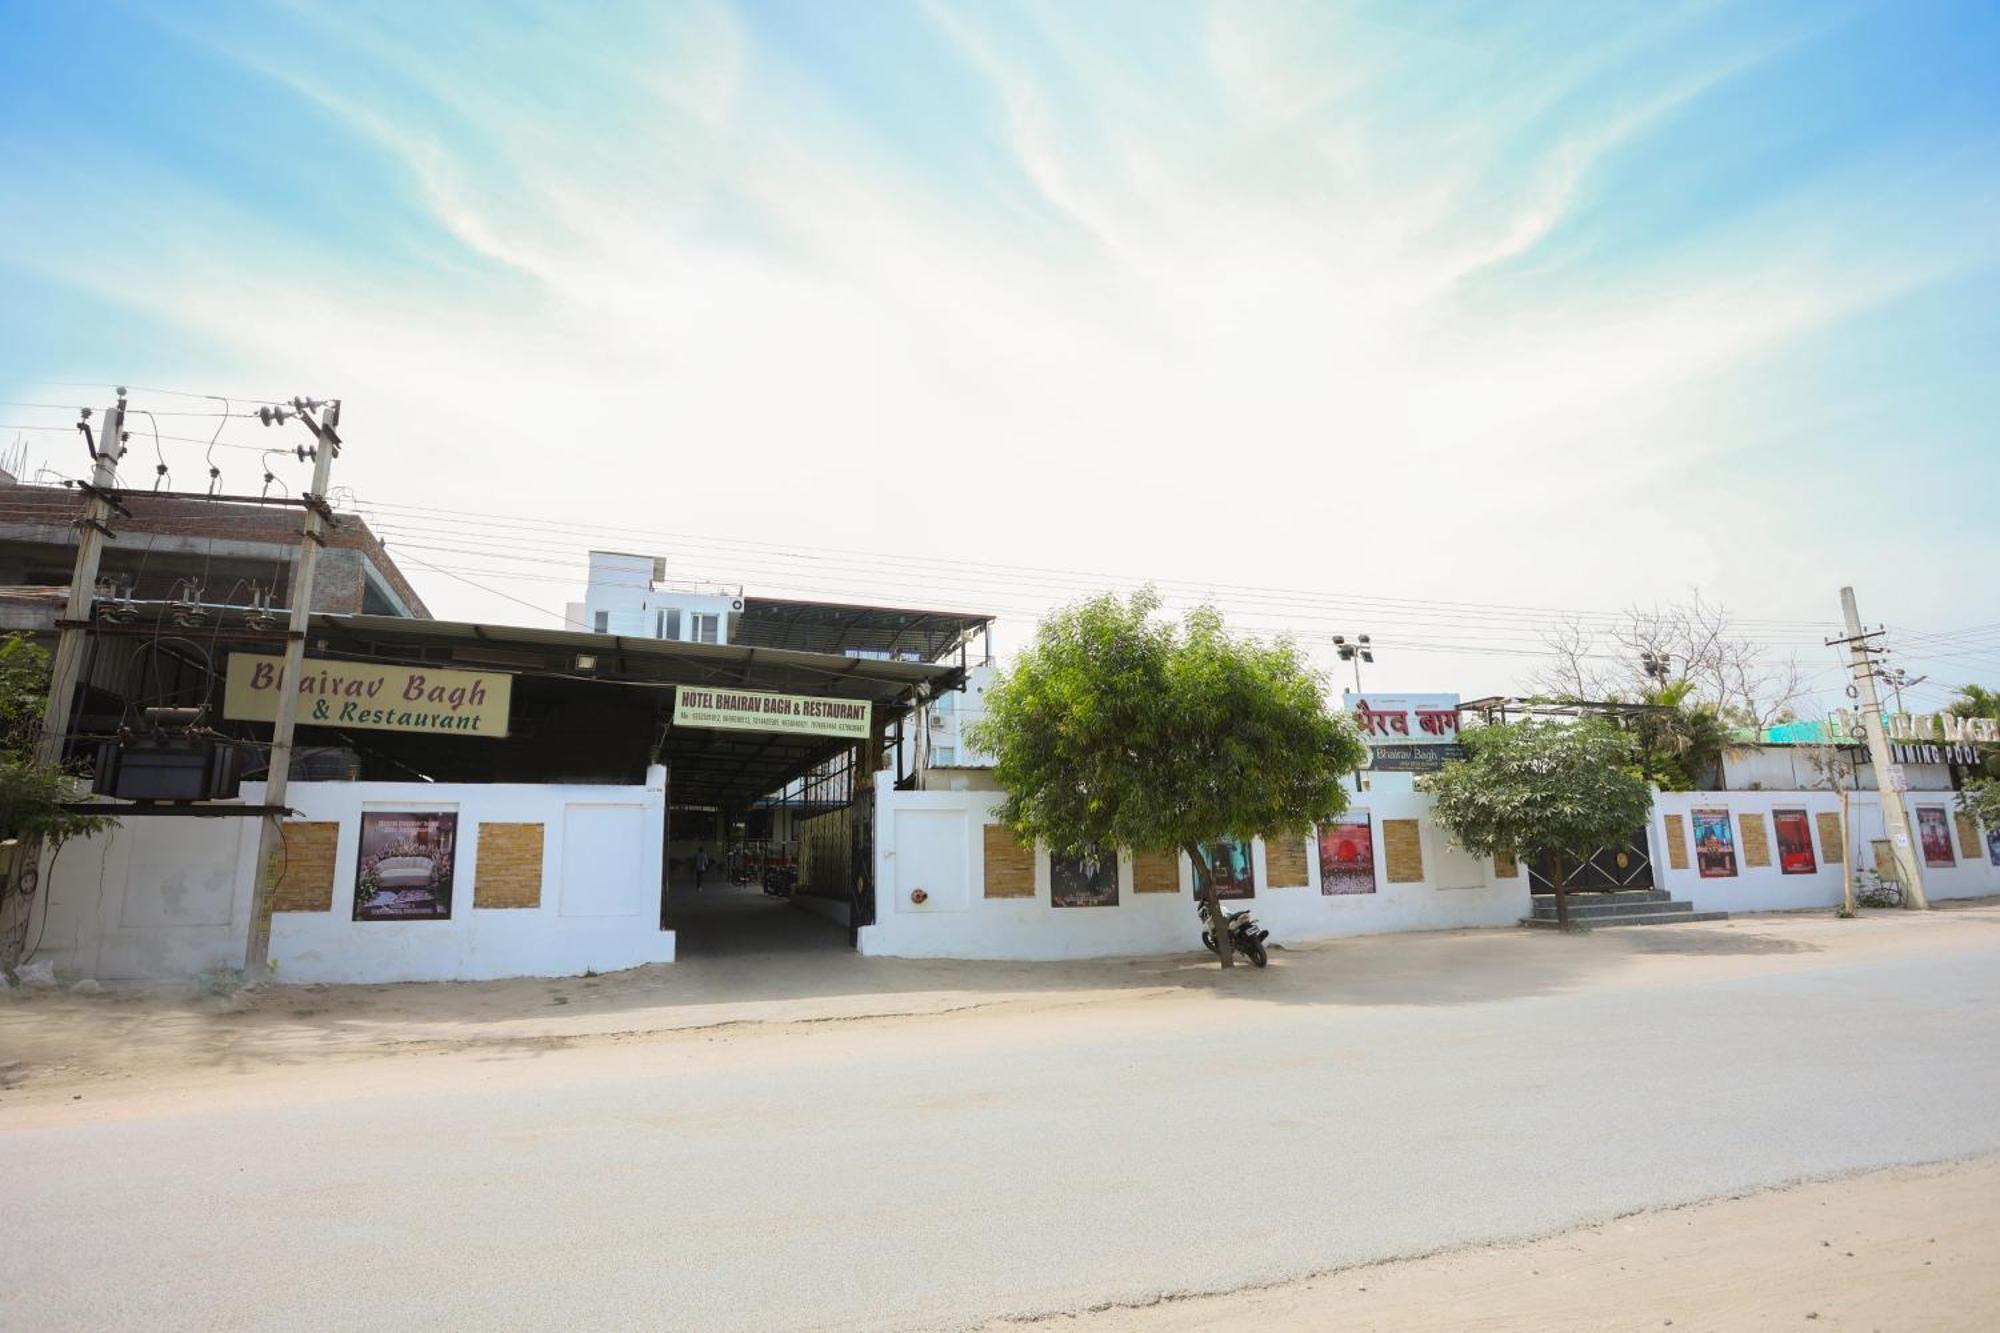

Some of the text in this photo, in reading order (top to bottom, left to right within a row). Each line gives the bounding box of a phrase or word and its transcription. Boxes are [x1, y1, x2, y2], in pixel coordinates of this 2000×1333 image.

[250, 662, 486, 710] Bairav Bagh
[312, 699, 480, 730] & Restaurant
[682, 691, 866, 720] HOTEL BHAIRAV BAGH & RESTAURANT
[1376, 748, 1411, 760] Bhairav
[1414, 748, 1438, 761] Bagh
[1946, 744, 1980, 764] POOL
